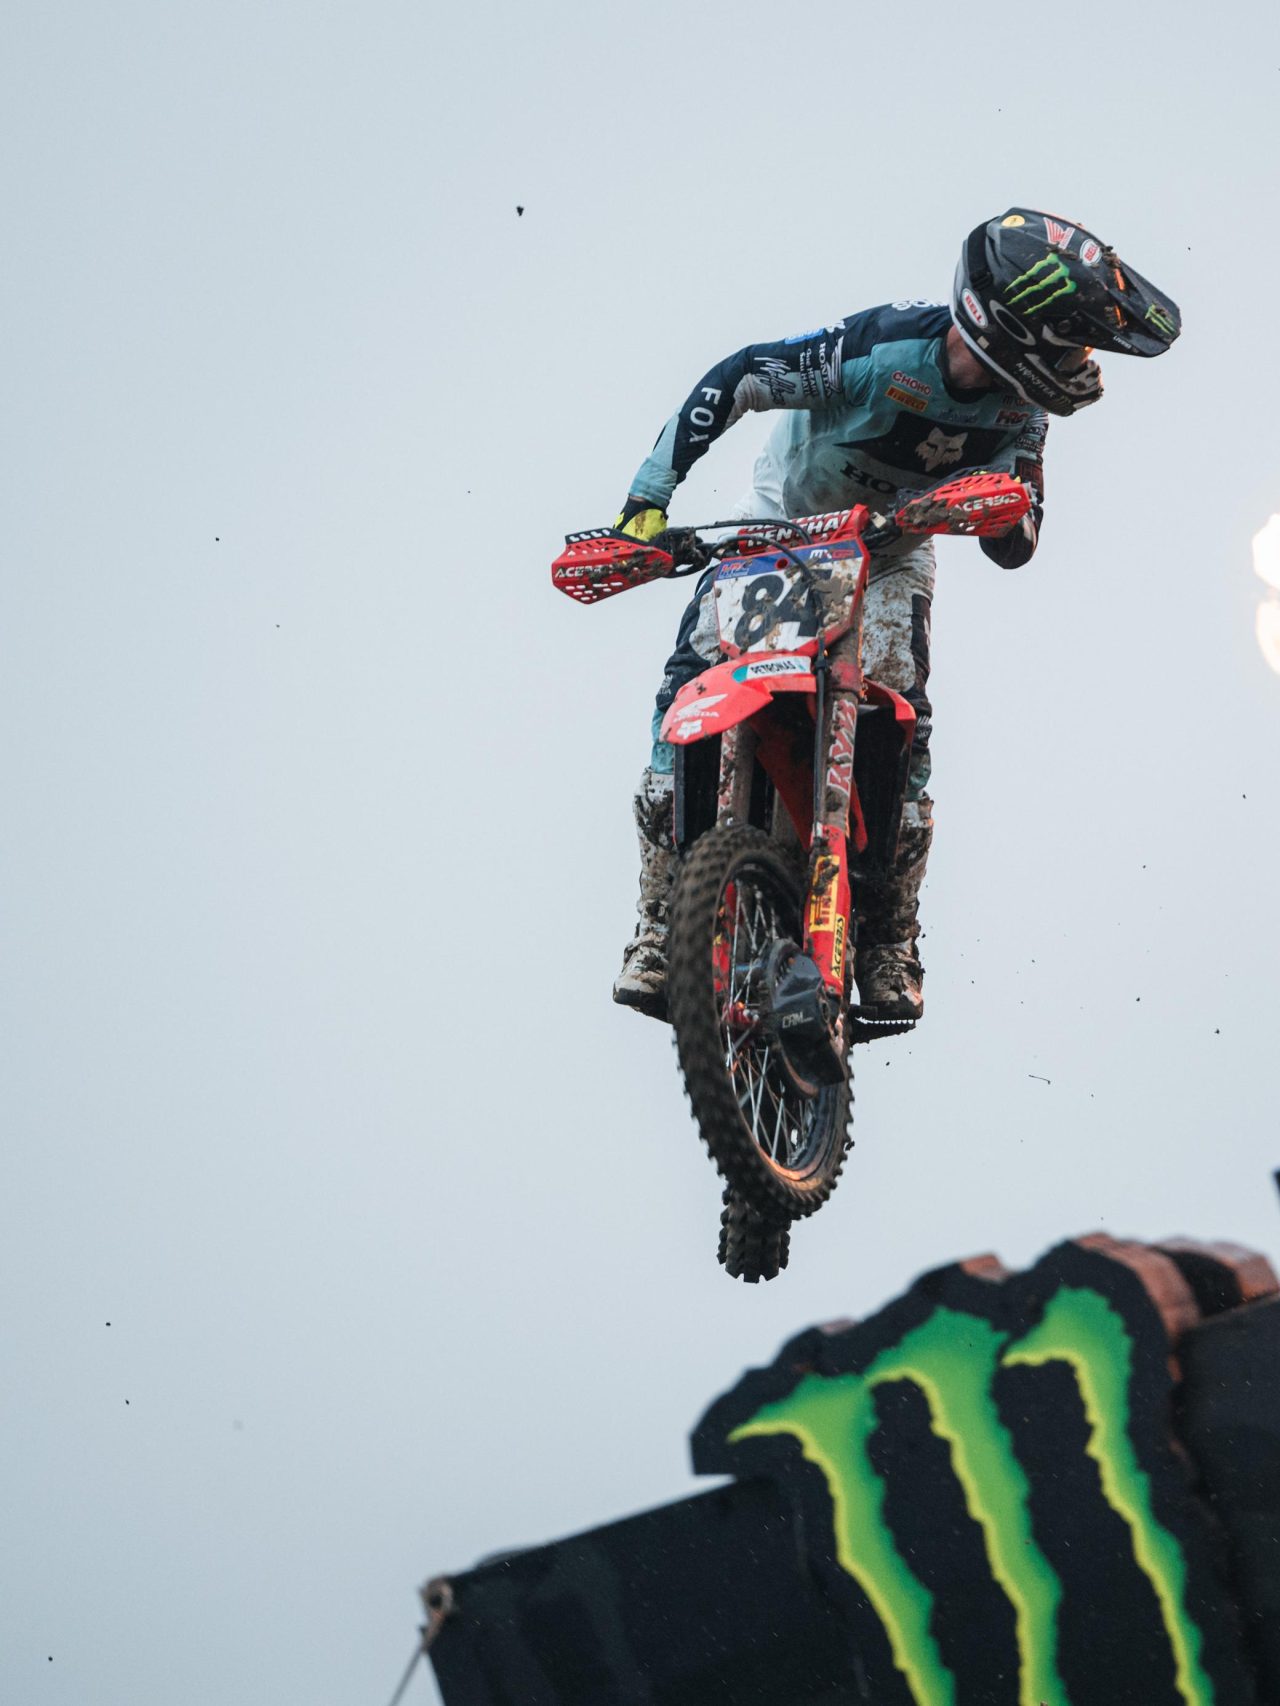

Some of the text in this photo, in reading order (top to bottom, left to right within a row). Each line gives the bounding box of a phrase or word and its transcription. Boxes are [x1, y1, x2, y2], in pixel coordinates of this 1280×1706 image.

[965, 294, 983, 323] BELL
[819, 342, 833, 397] HONDA
[892, 371, 931, 396] CHOHO
[1016, 362, 1056, 397] MONSTER
[734, 568, 834, 648] 84
[751, 661, 797, 675] PETRONAS
[832, 917, 844, 977] ACERBIS
